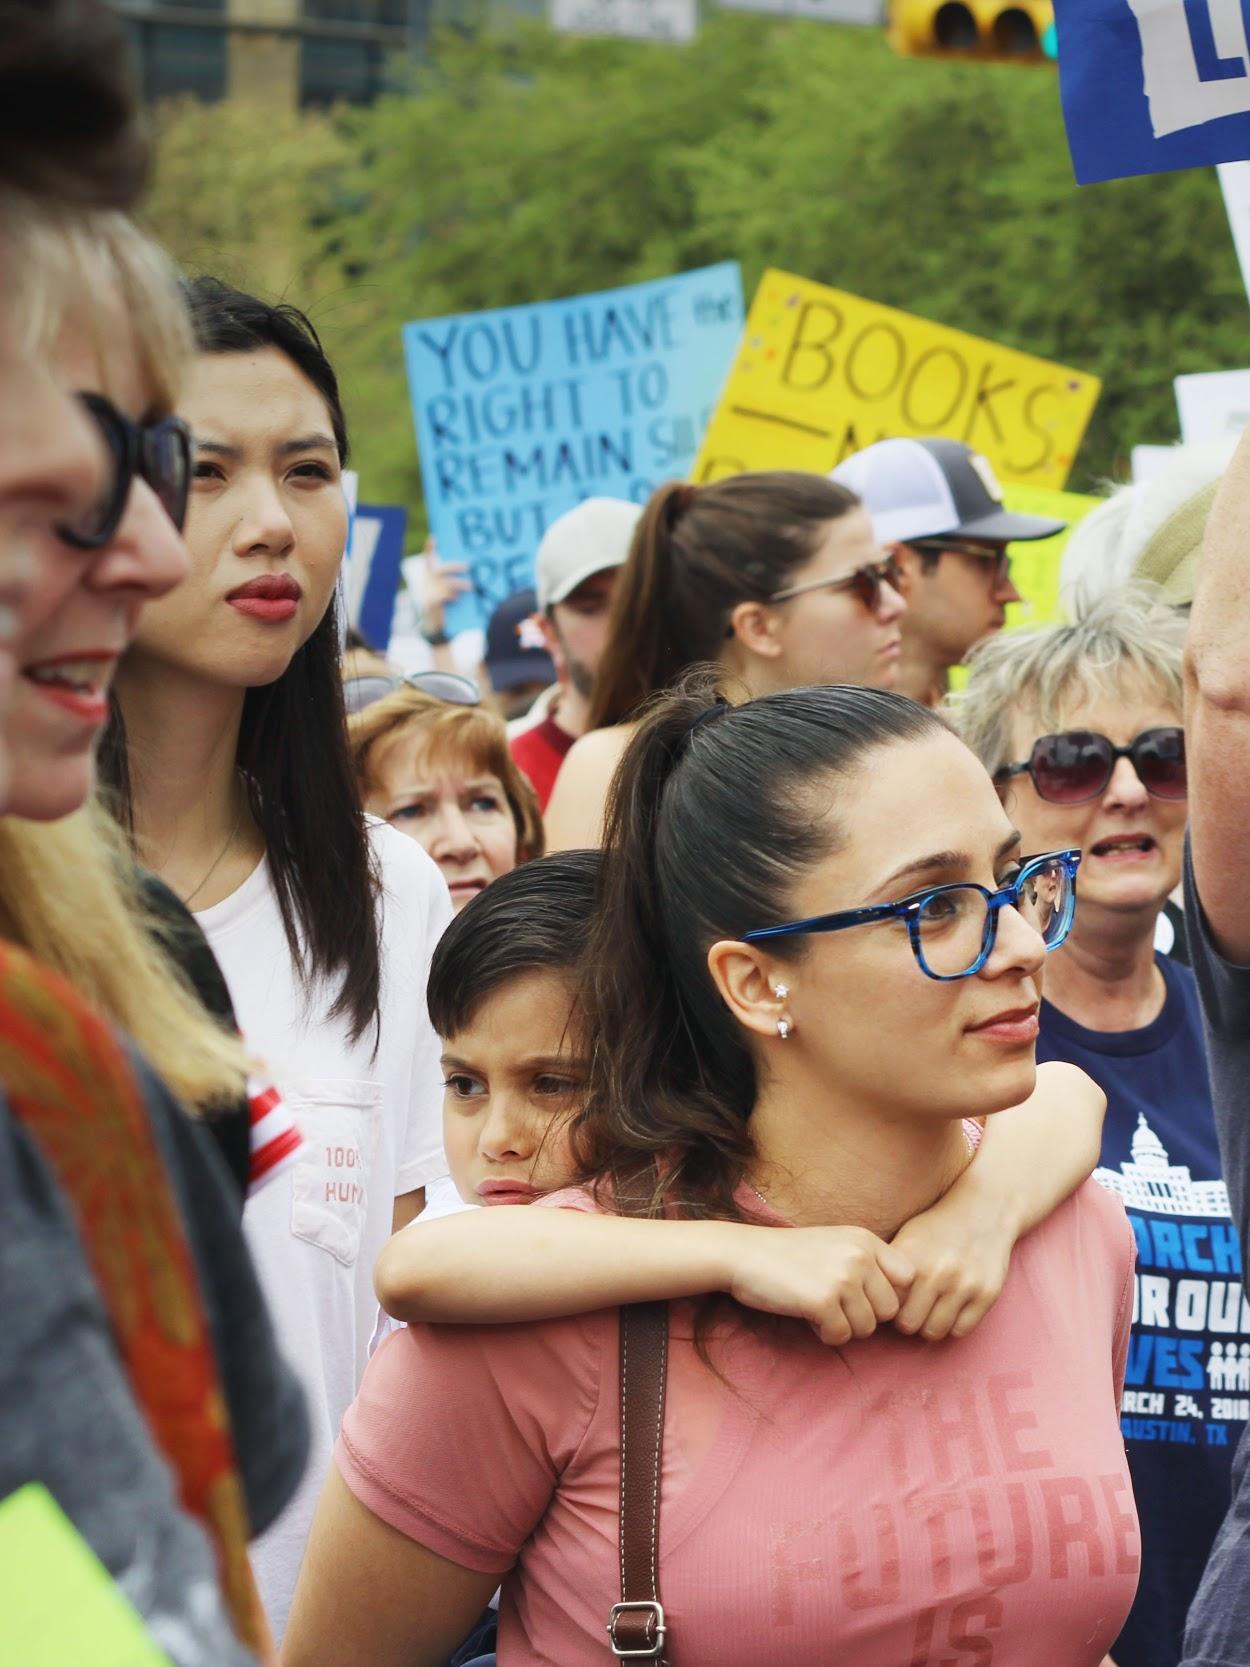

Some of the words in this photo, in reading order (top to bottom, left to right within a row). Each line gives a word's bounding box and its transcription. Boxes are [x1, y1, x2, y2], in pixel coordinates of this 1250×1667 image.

[416, 313, 541, 389] YOU
[563, 294, 682, 367] HAVE
[425, 377, 584, 447] RIGHT
[610, 361, 669, 418] TO
[780, 301, 1059, 475] BOOKS
[435, 426, 633, 502] REMAIN
[872, 1371, 1055, 1487] THE
[1174, 1394, 1204, 1419] 24,
[1205, 1423, 1228, 1445] TX
[768, 1472, 1140, 1627] FUTURE
[908, 1595, 1004, 1667] IS
